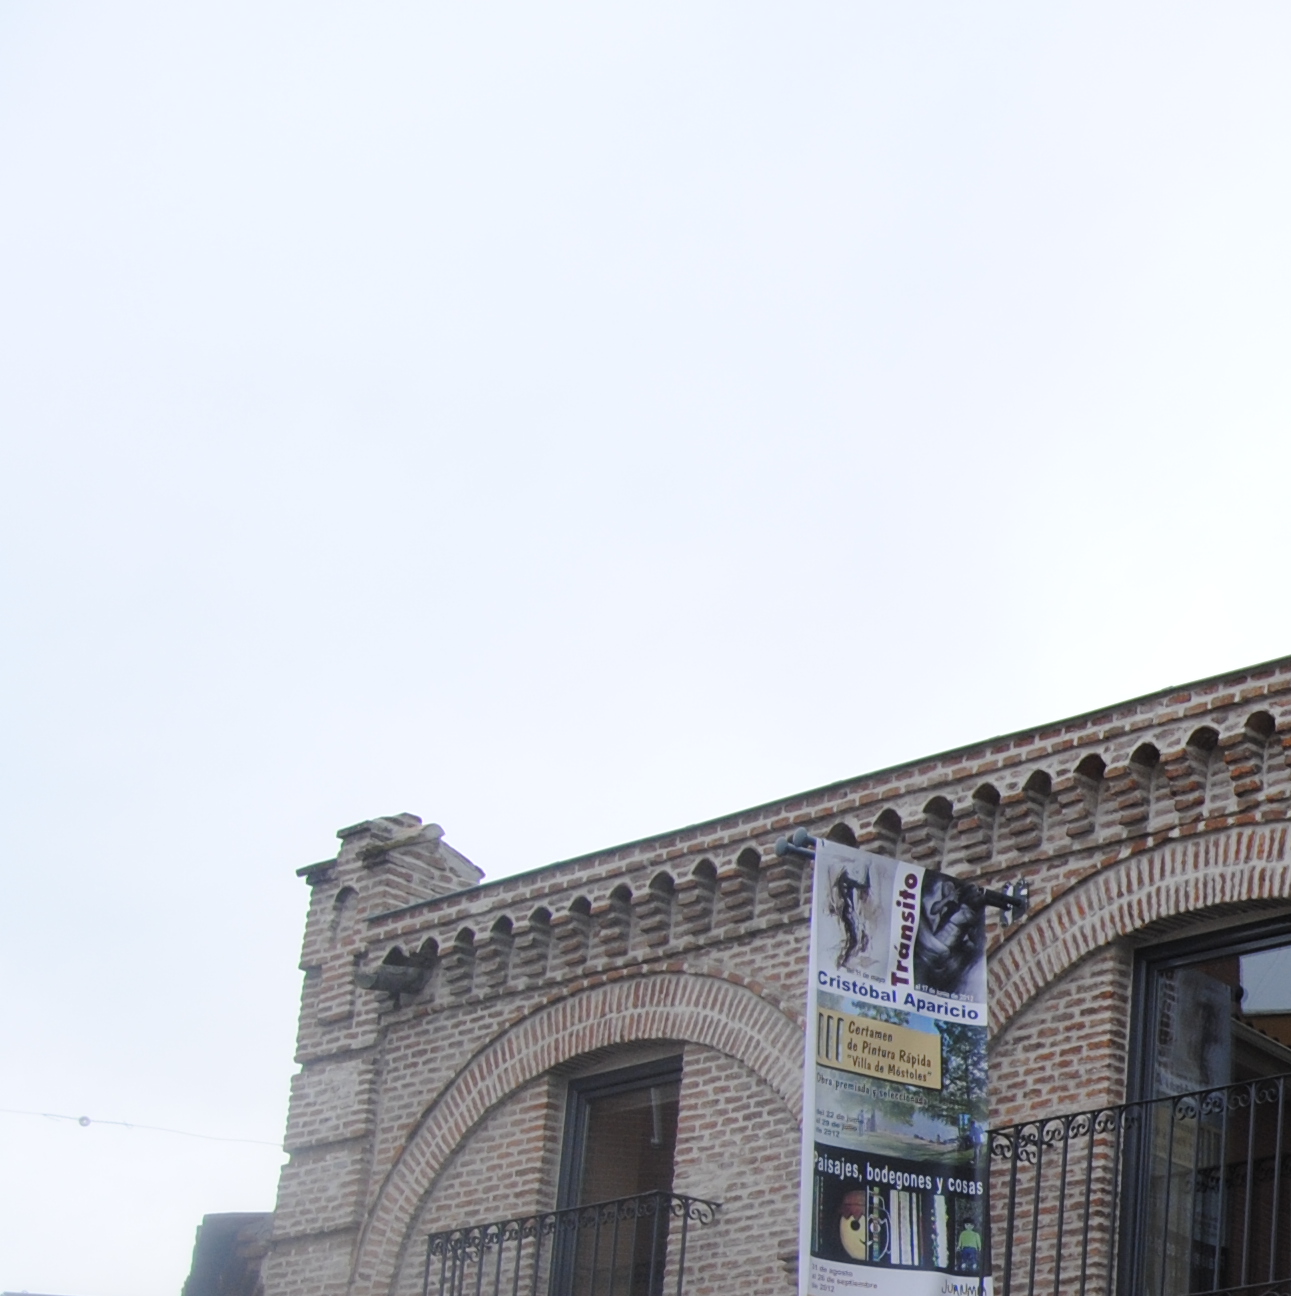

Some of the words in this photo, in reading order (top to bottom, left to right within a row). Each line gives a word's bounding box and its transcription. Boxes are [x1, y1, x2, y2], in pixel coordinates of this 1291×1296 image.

[890, 873, 919, 987] Tránsito
[818, 970, 897, 1003] Cristóbal
[904, 992, 979, 1020] Aparicio
[848, 1020, 893, 1043] Certamen
[862, 1040, 896, 1061] Pintura
[899, 1049, 932, 1069] Rápida
[874, 1061, 884, 1074] de
[835, 1080, 870, 1096] premiada
[866, 1162, 932, 1190] bodegones
[936, 1176, 944, 1194] y
[948, 1177, 983, 1196] cosas
